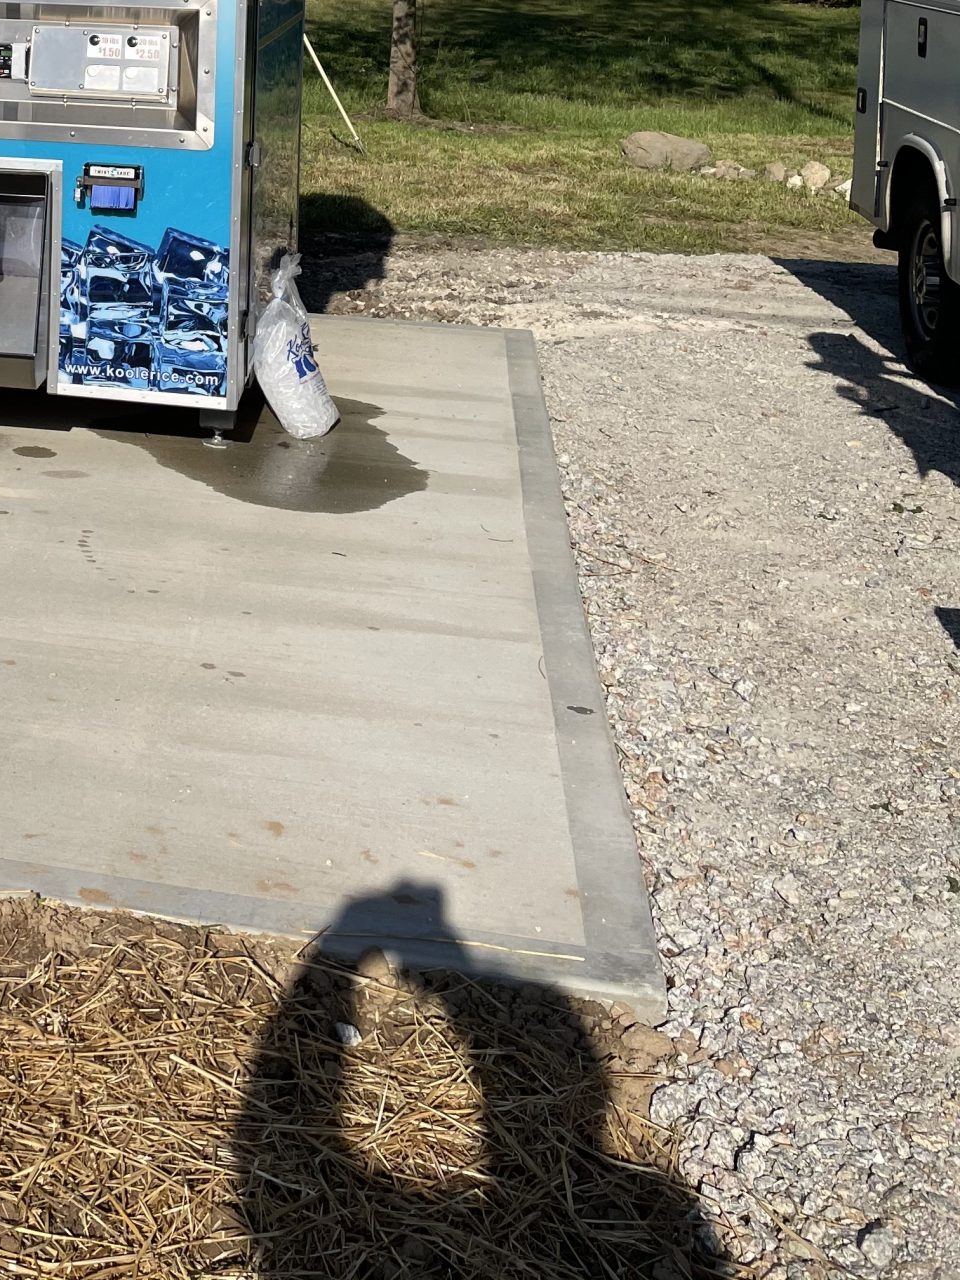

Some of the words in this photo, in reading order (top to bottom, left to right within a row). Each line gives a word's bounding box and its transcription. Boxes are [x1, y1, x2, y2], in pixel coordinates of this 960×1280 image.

[98, 47, 121, 58] $1.50
[135, 48, 160, 59] $2.50
[64, 363, 219, 386] www.koolerice.com
